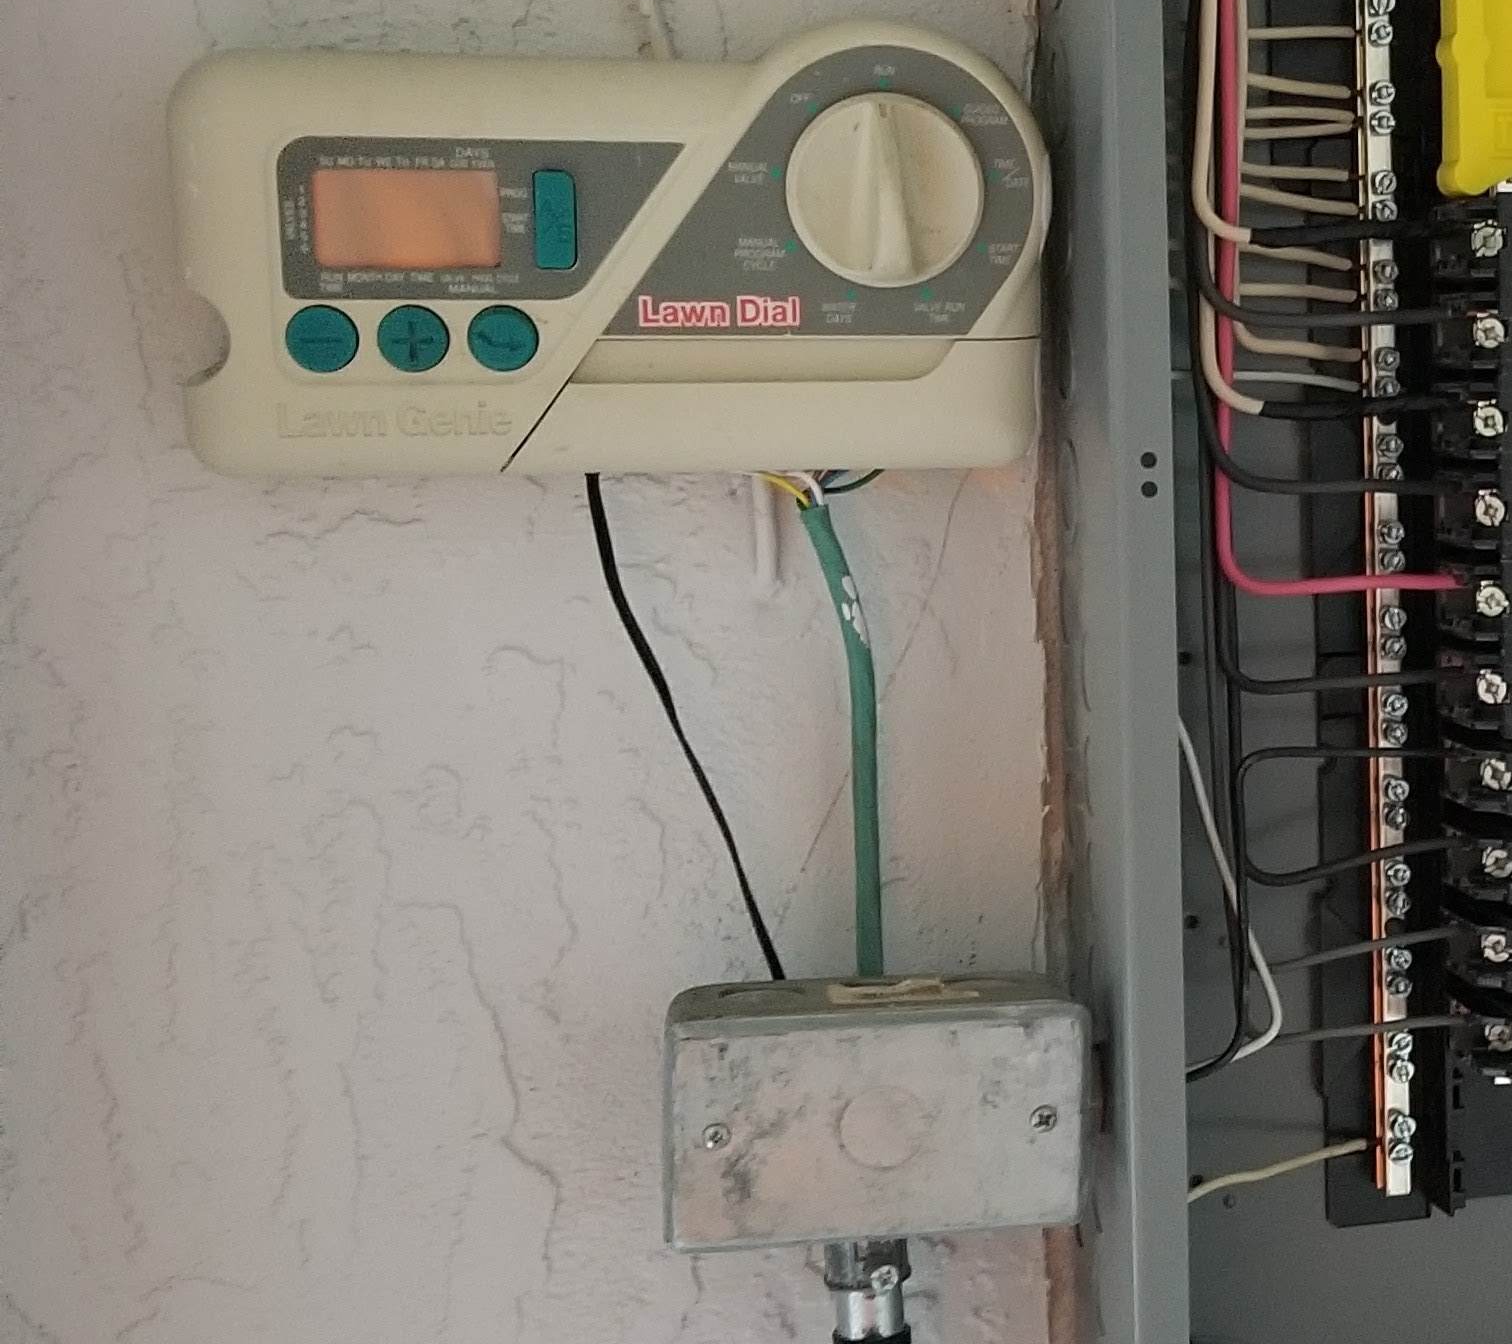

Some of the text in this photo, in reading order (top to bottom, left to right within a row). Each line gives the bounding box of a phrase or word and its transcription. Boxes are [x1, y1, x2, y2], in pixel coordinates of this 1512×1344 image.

[638, 295, 800, 327] Lawn Dial
[277, 400, 513, 439] Lawn Genie
